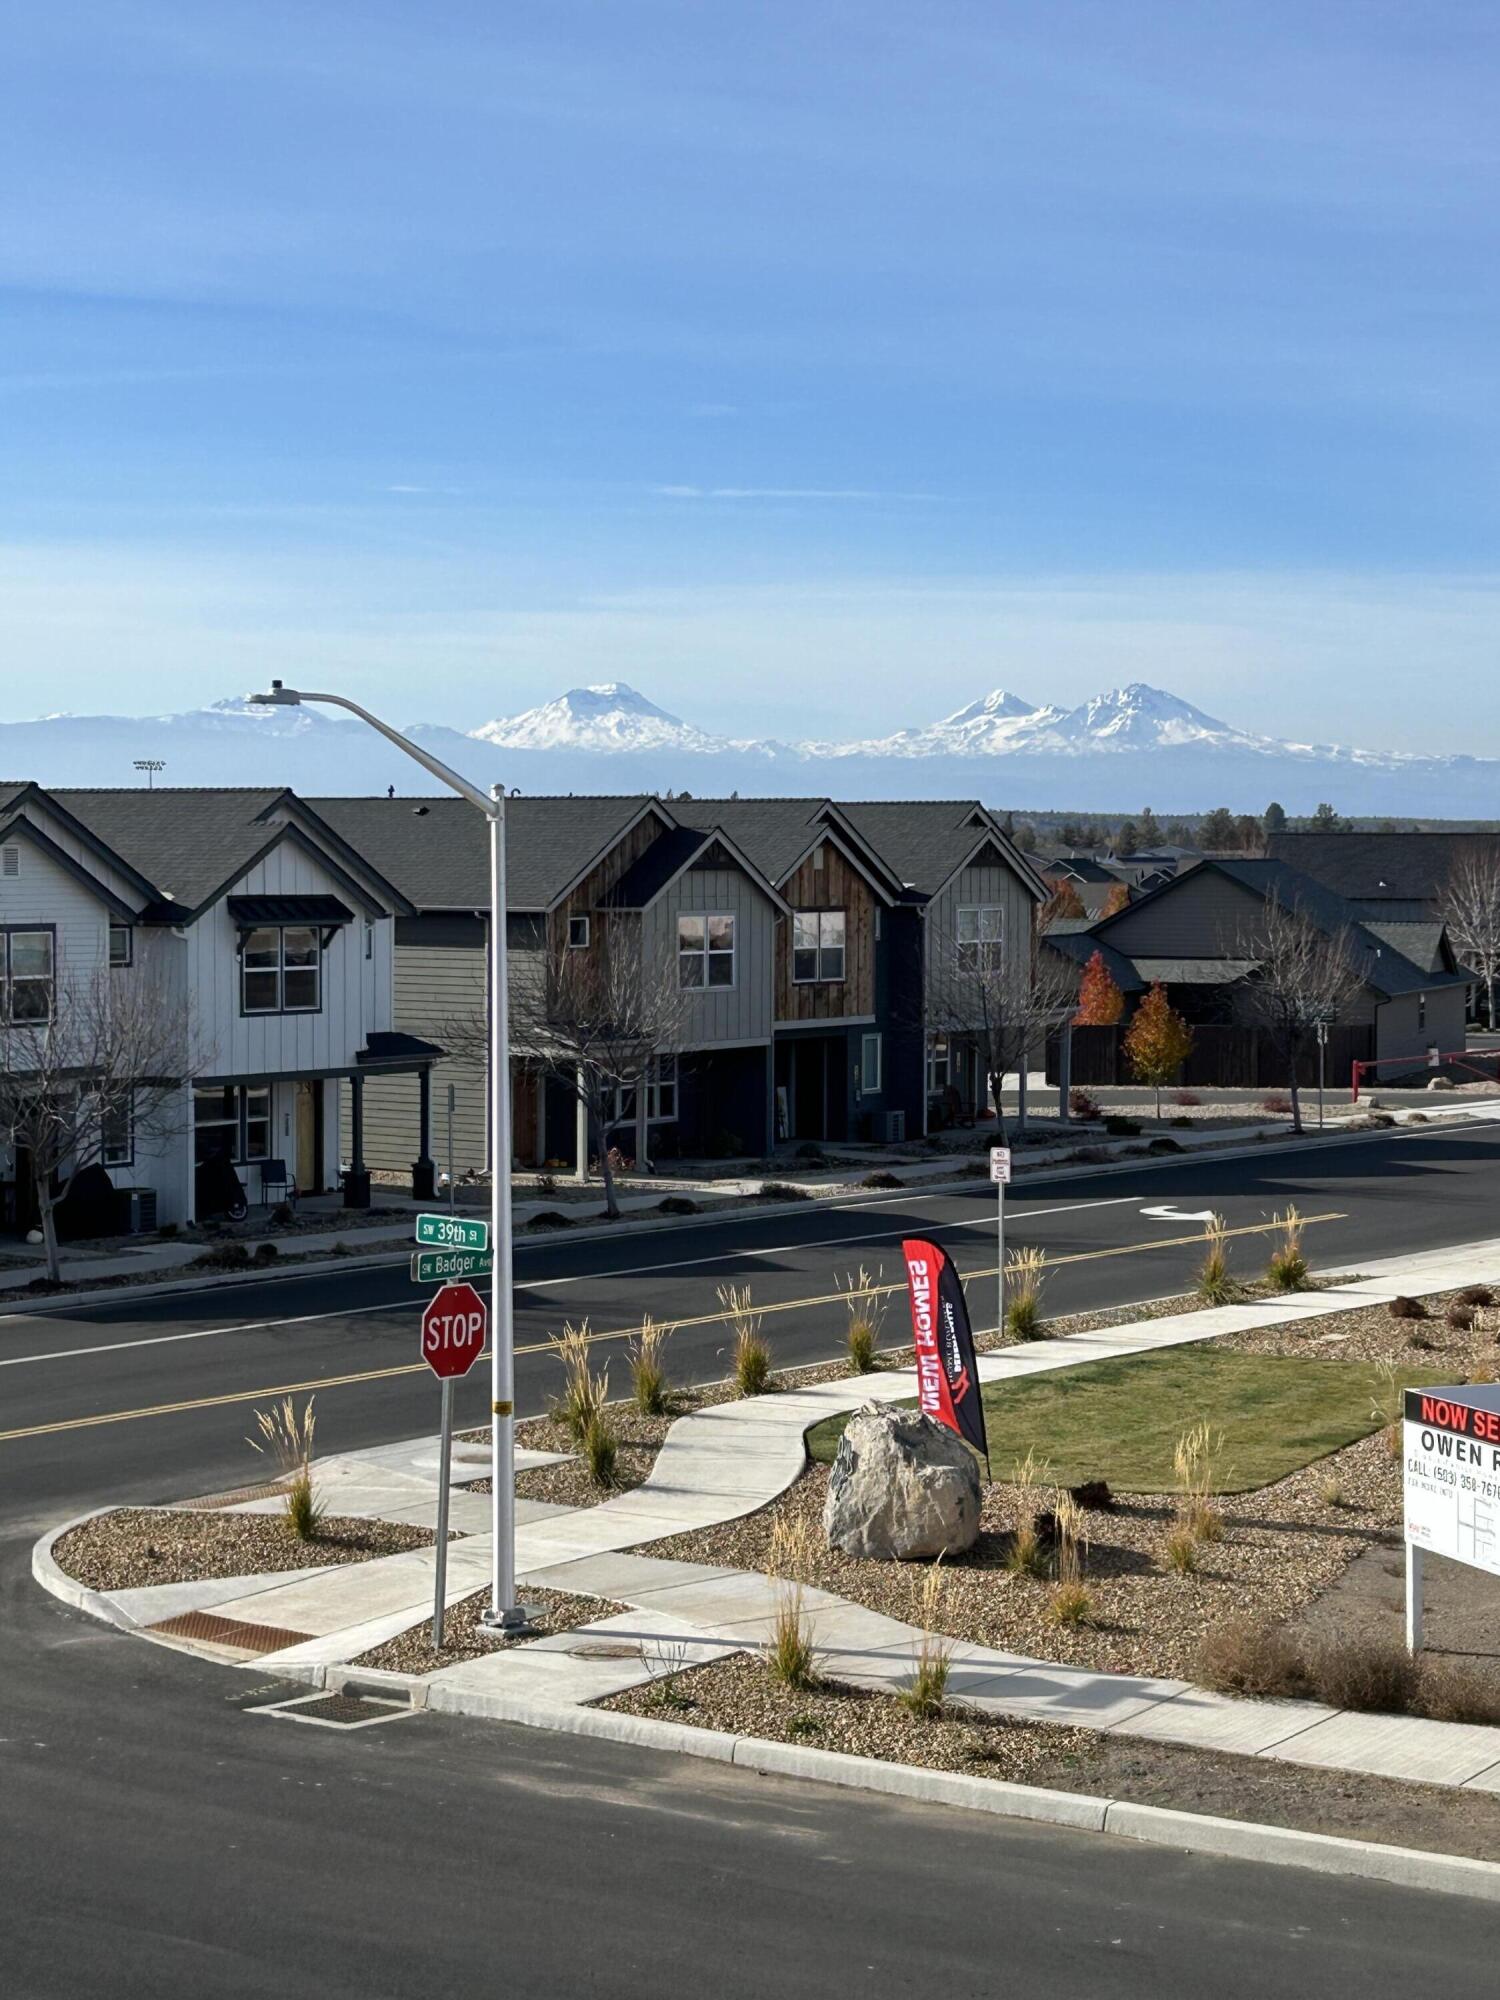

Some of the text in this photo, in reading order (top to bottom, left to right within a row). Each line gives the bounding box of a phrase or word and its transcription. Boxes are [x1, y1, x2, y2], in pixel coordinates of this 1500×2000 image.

[424, 1225, 434, 1235] SW
[438, 1223, 466, 1243] 39th
[422, 1264, 432, 1274] SW
[435, 1255, 475, 1277] Badger
[427, 1313, 481, 1351] STOP
[1423, 1397, 1499, 1440] NOW SE
[1421, 1430, 1482, 1467] OWEN
[1433, 1466, 1457, 1487] (503)
